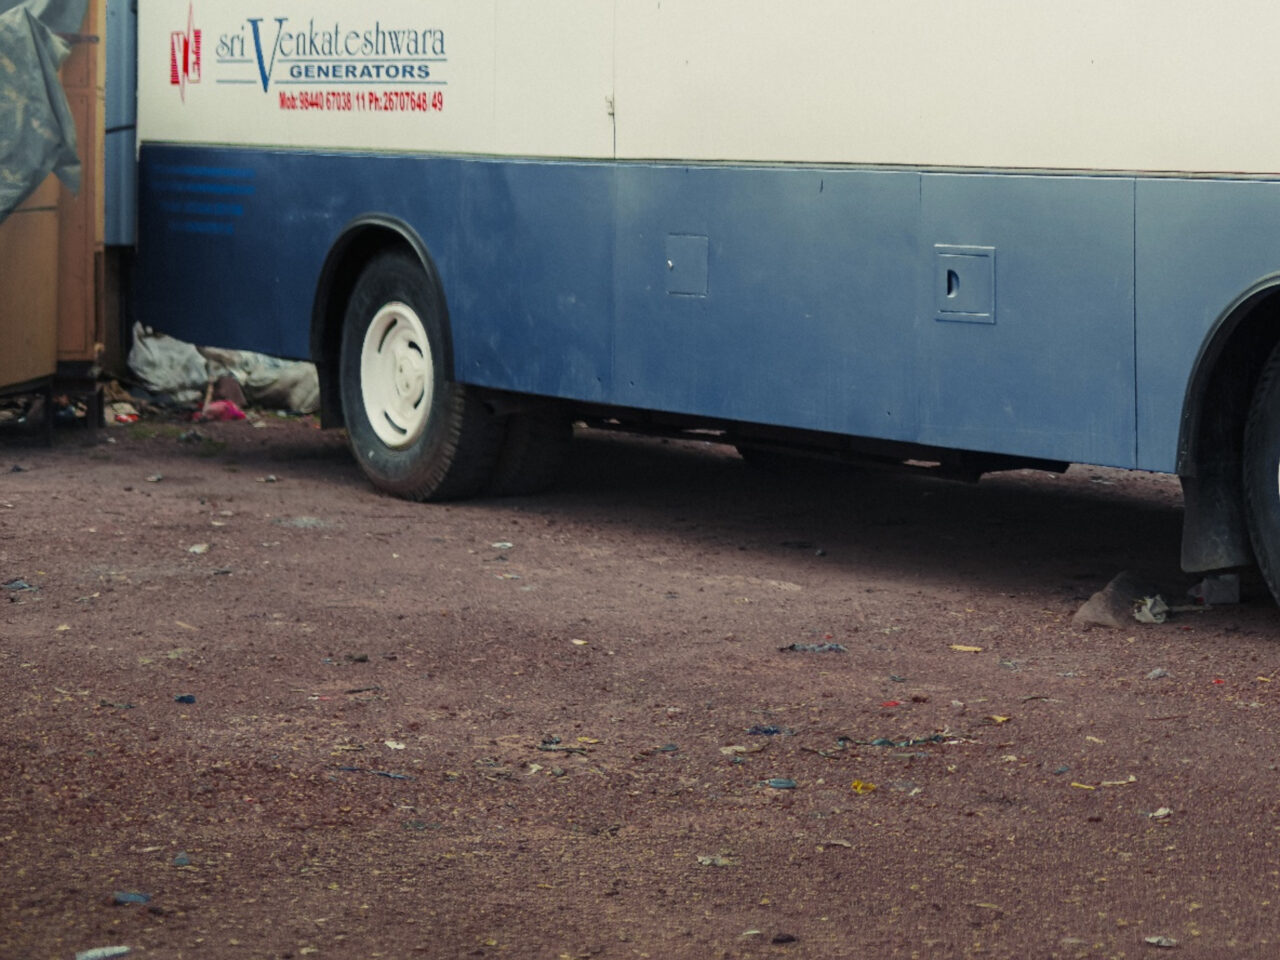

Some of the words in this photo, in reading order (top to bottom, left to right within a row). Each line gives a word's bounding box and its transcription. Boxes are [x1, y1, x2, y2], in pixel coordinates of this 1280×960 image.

[215, 25, 246, 58] sri
[247, 17, 446, 93] Venkateshwara
[289, 64, 430, 79] GENERATORS
